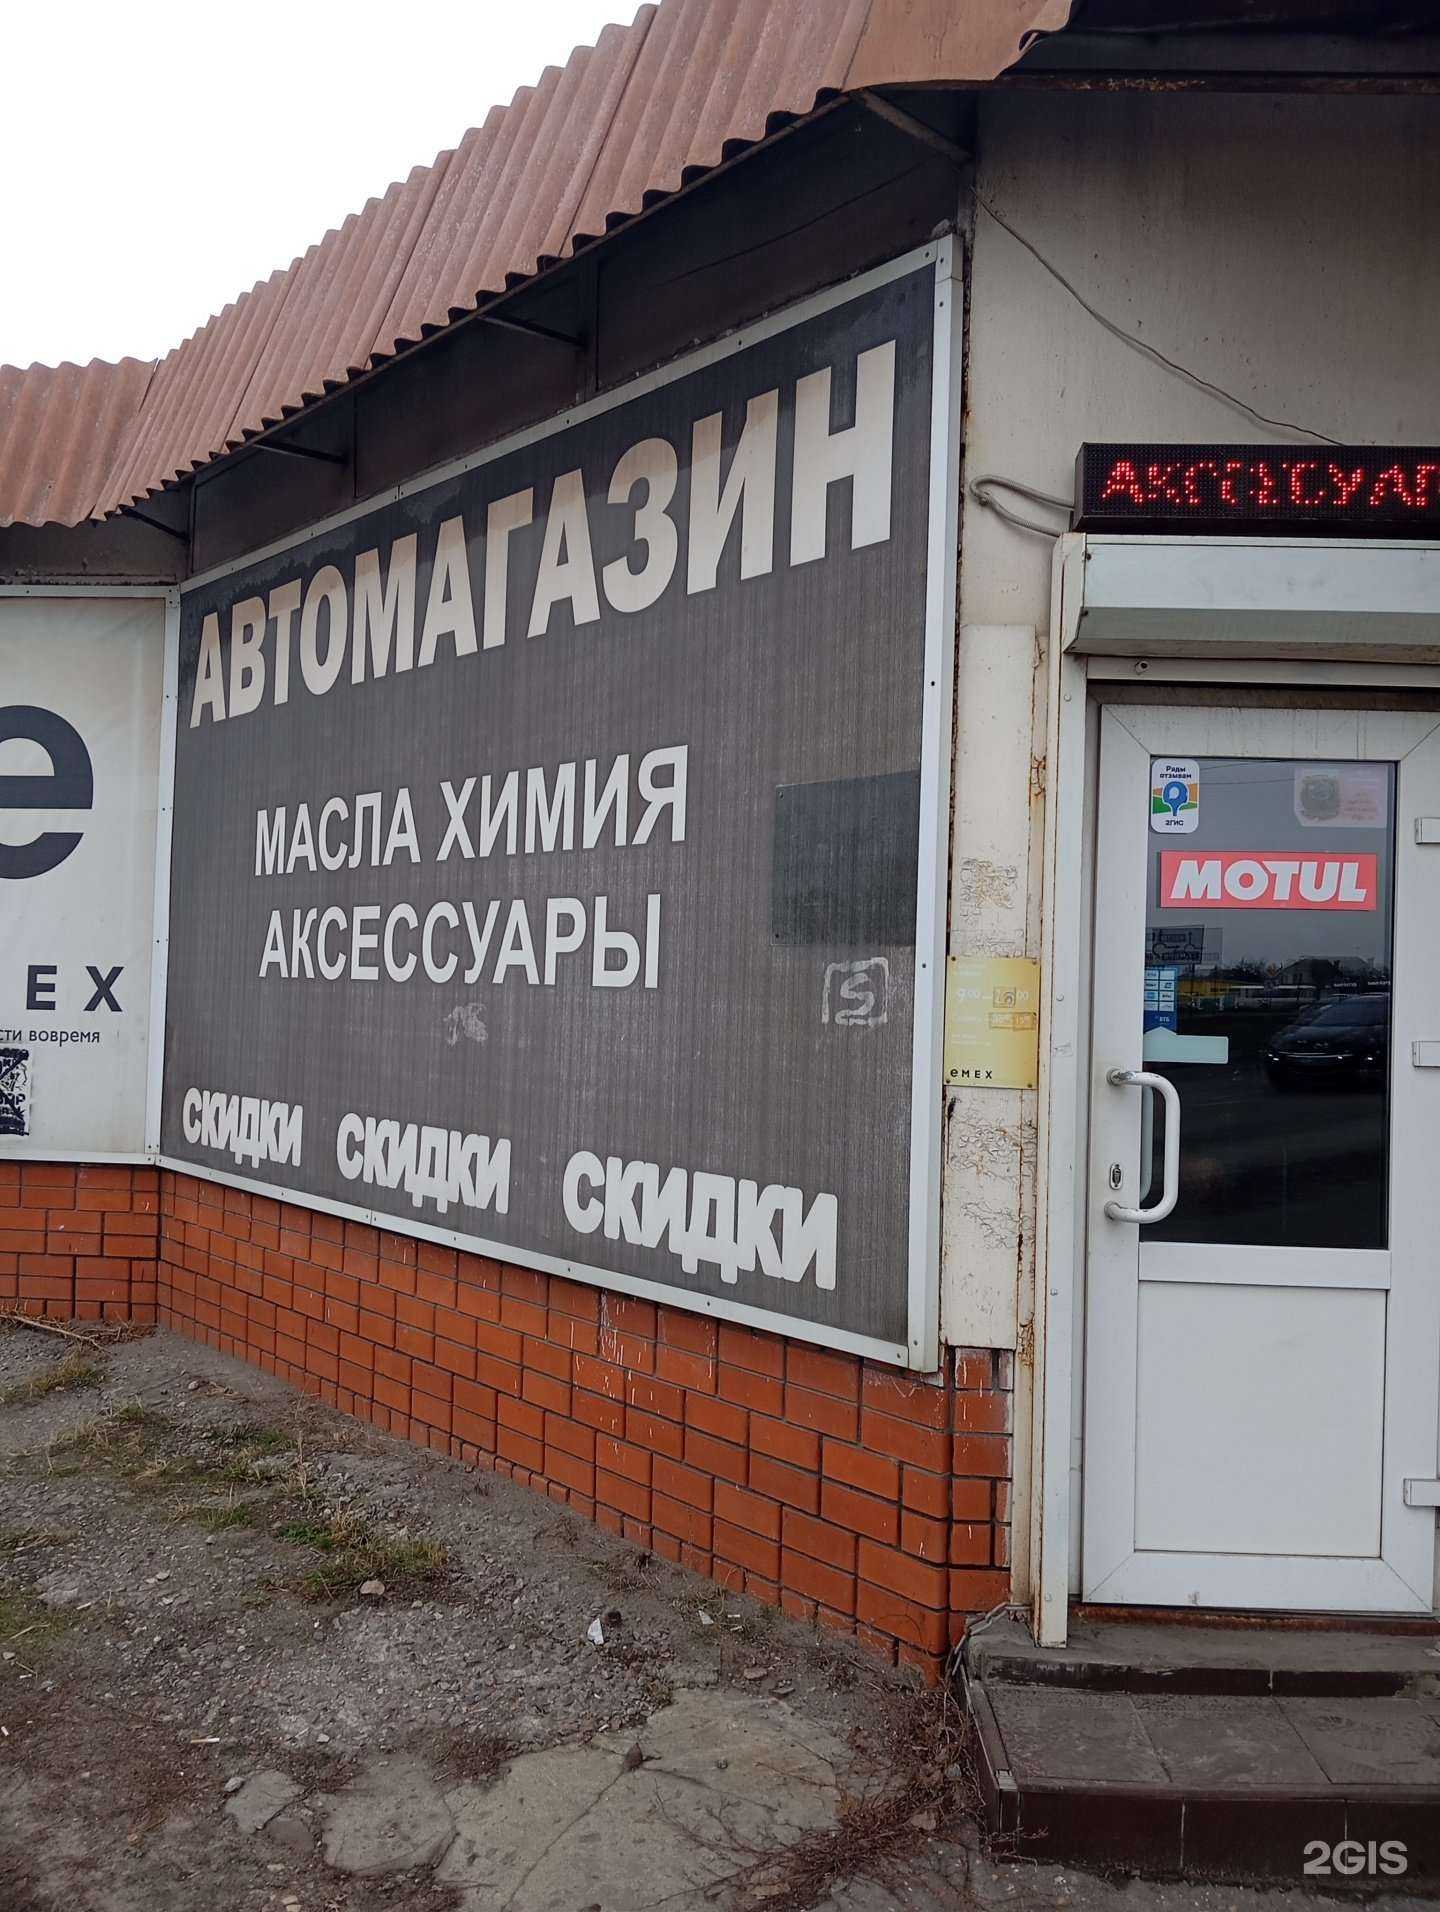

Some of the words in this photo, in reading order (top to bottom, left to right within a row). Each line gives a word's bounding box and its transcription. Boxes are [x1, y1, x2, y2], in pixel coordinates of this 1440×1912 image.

[191, 340, 896, 728] АВТОМАГАЗИН
[255, 788, 421, 876] МАСЛА
[436, 744, 688, 861] ХИМИЯ
[1170, 860, 1367, 902] MOTUL
[259, 894, 660, 988] АКСЕССУАРЫ
[29, 1030, 100, 1047] вовремя
